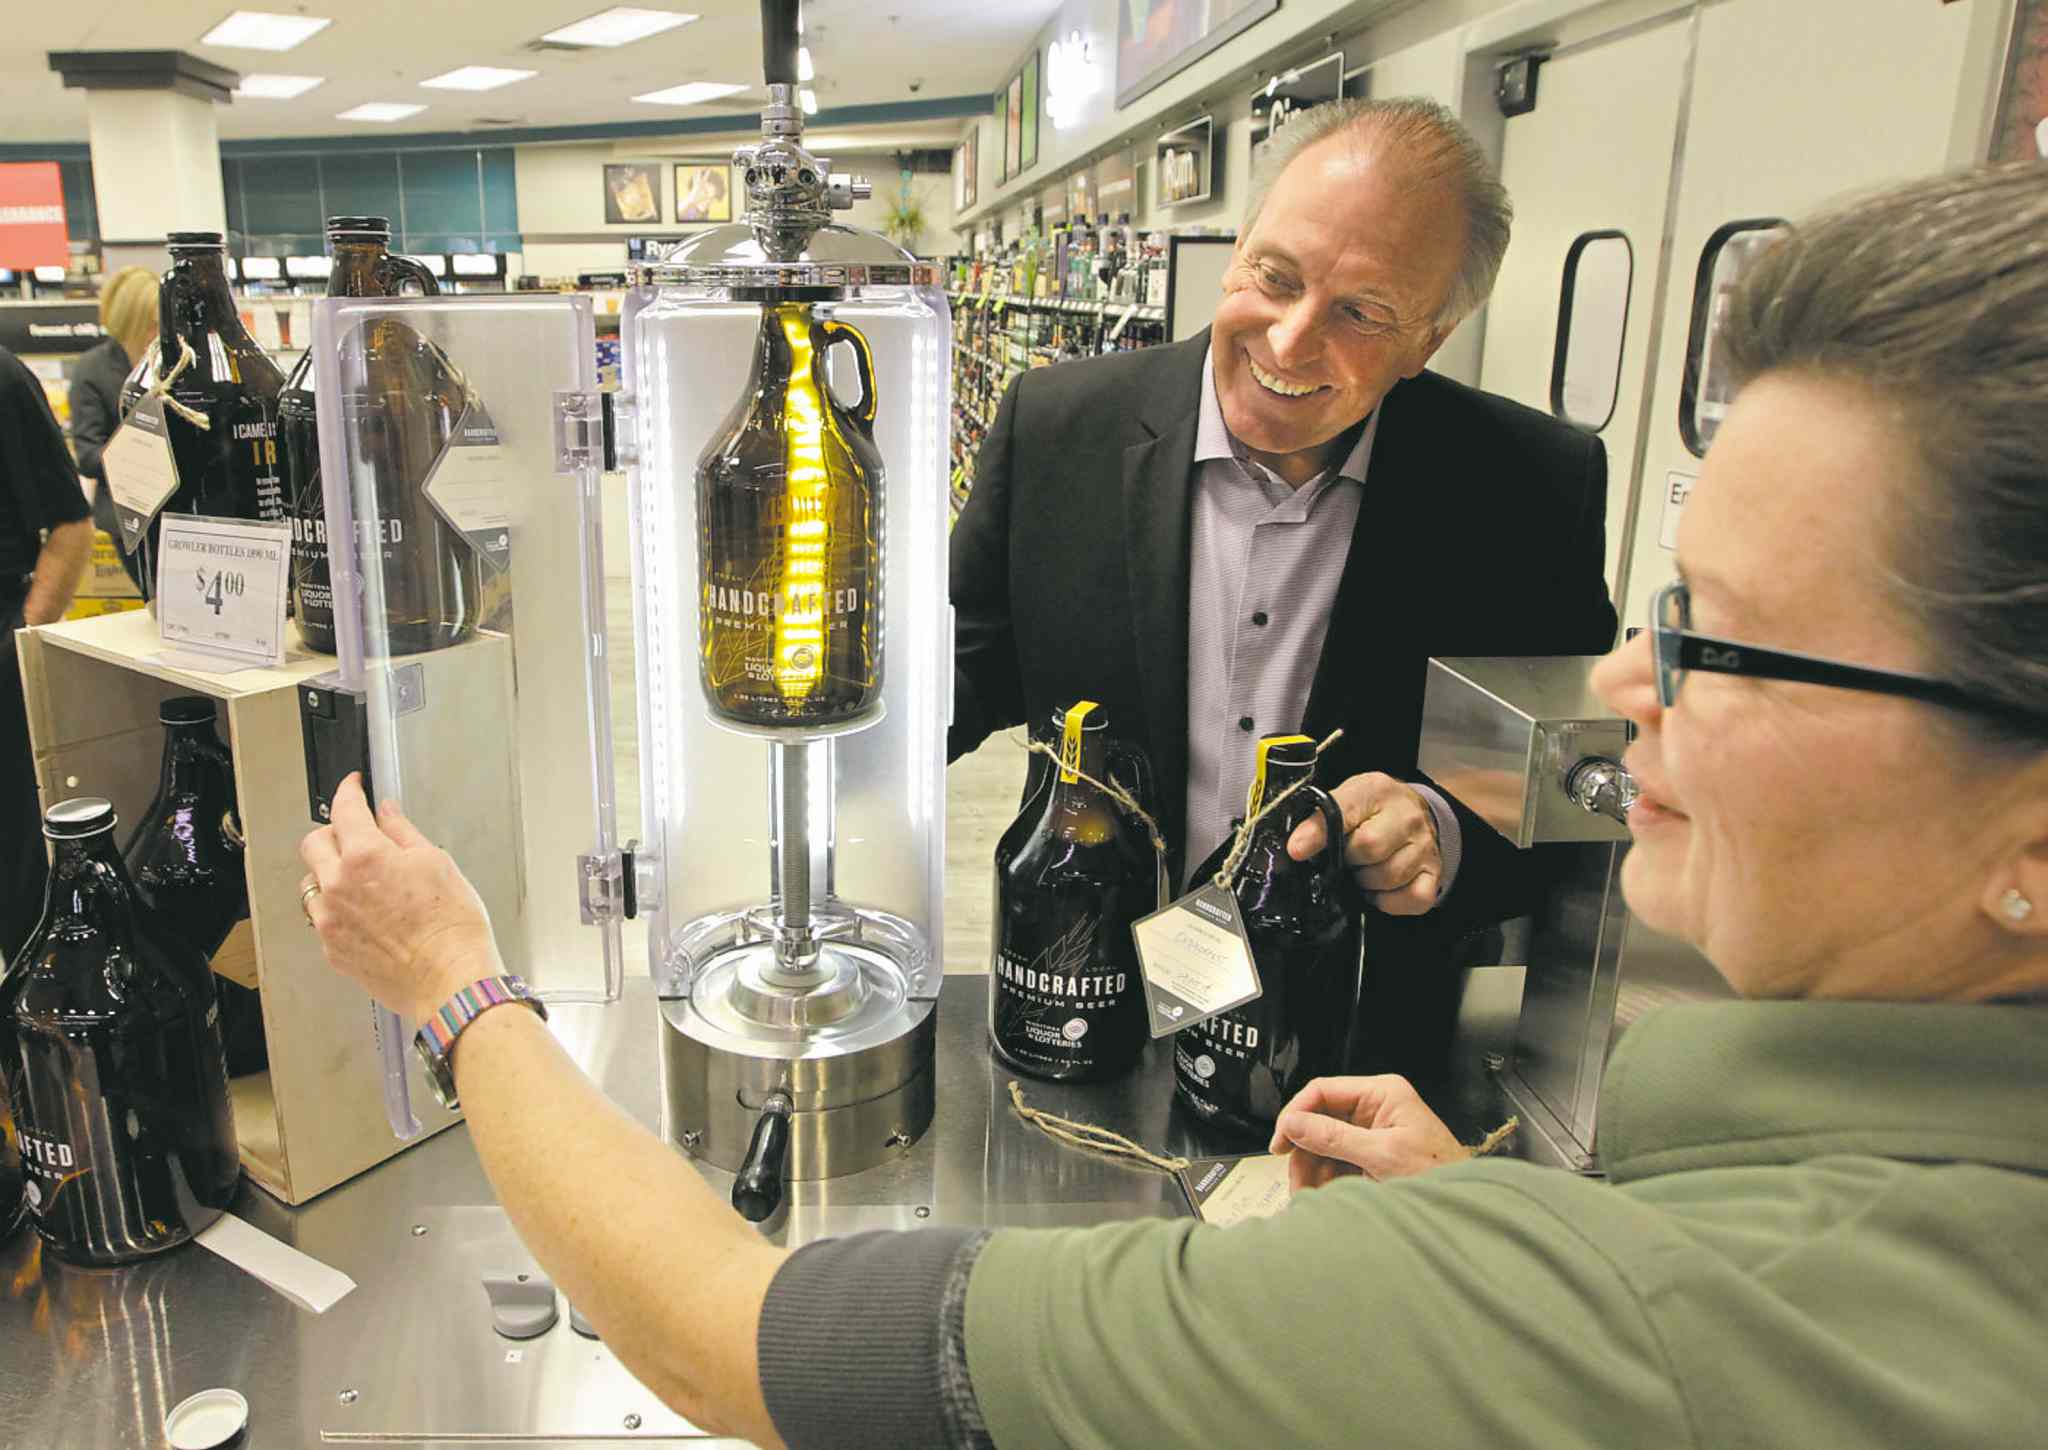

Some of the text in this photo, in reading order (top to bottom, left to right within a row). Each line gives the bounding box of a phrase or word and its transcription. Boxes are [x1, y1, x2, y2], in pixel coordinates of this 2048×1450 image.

[997, 953, 1126, 998] HANDCRAFTED
[1002, 982, 1065, 1009] PREMIUM
[1075, 999, 1116, 1010] BEER
[1025, 1025, 1061, 1040] LIQUOR
[1034, 1034, 1083, 1049] LOTTERIES
